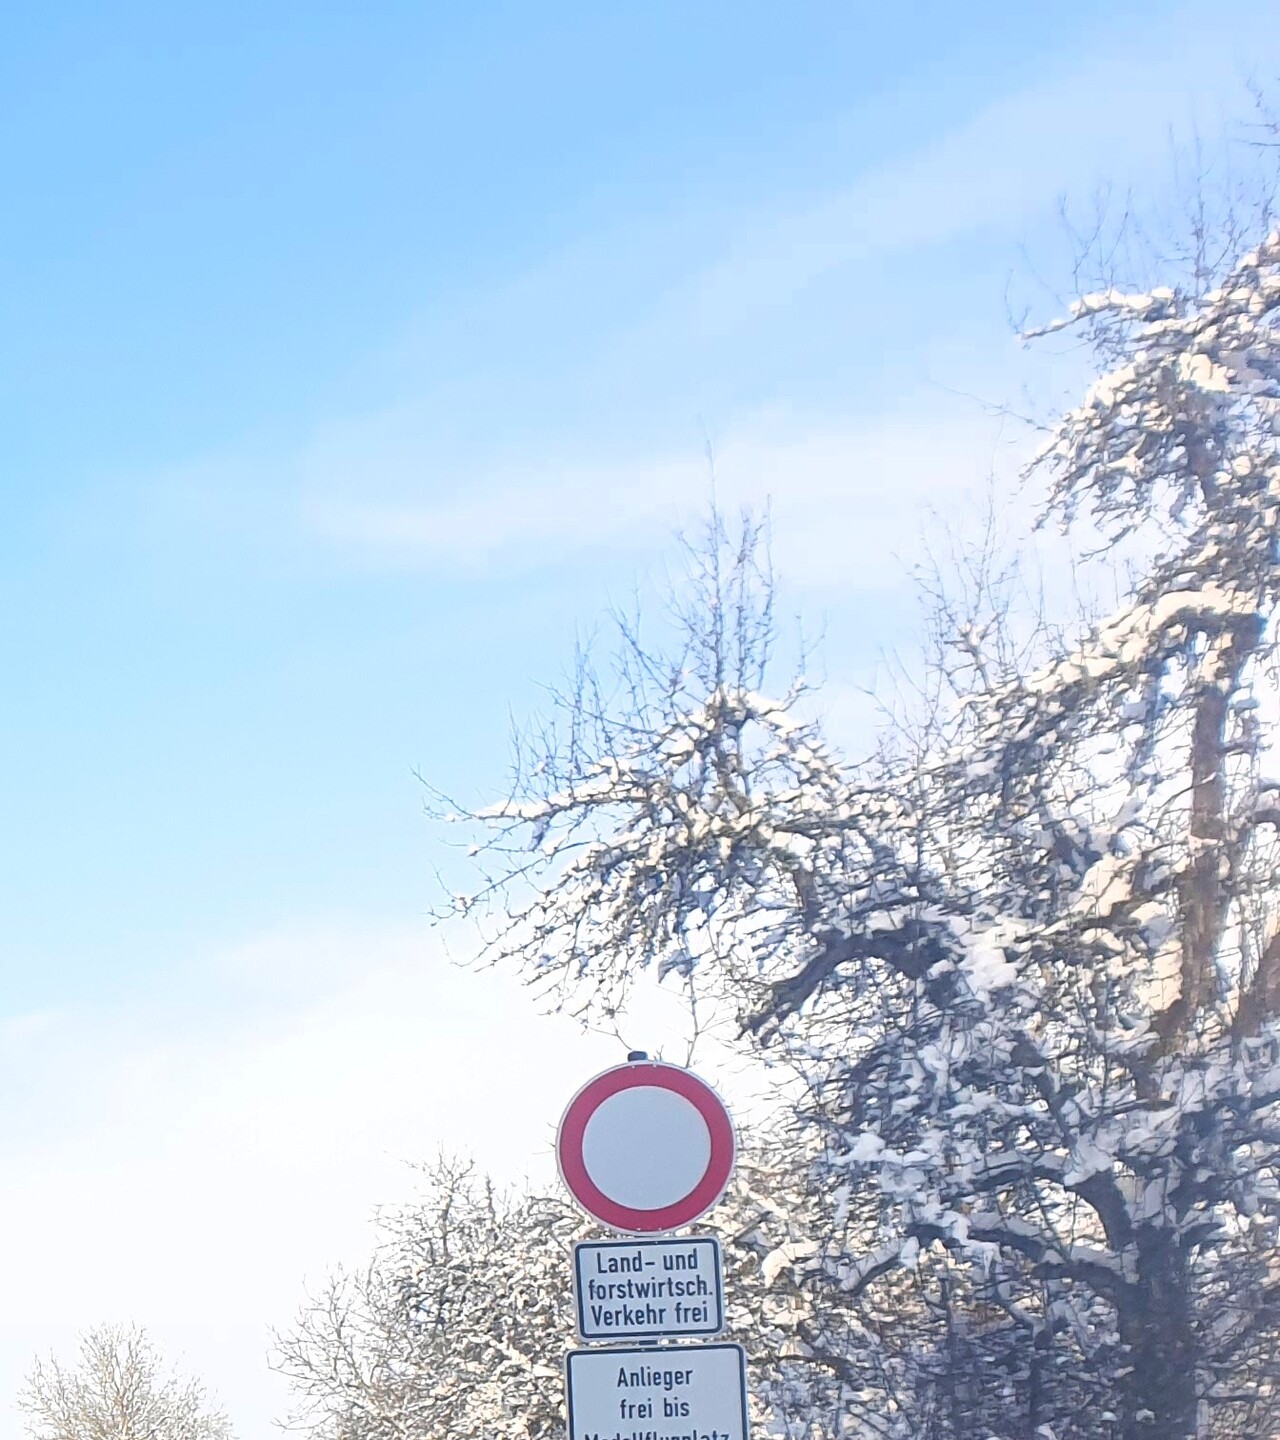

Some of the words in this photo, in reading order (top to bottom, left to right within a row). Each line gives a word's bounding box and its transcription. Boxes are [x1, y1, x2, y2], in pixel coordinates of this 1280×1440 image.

[596, 1250, 656, 1274] Land-
[662, 1247, 699, 1271] und
[588, 1274, 713, 1300] forstwirtsch.
[590, 1302, 667, 1327] Verkehr
[674, 1300, 708, 1323] frei
[617, 1366, 693, 1391] Anlieger
[620, 1397, 653, 1419] frei
[663, 1396, 690, 1418] bis
